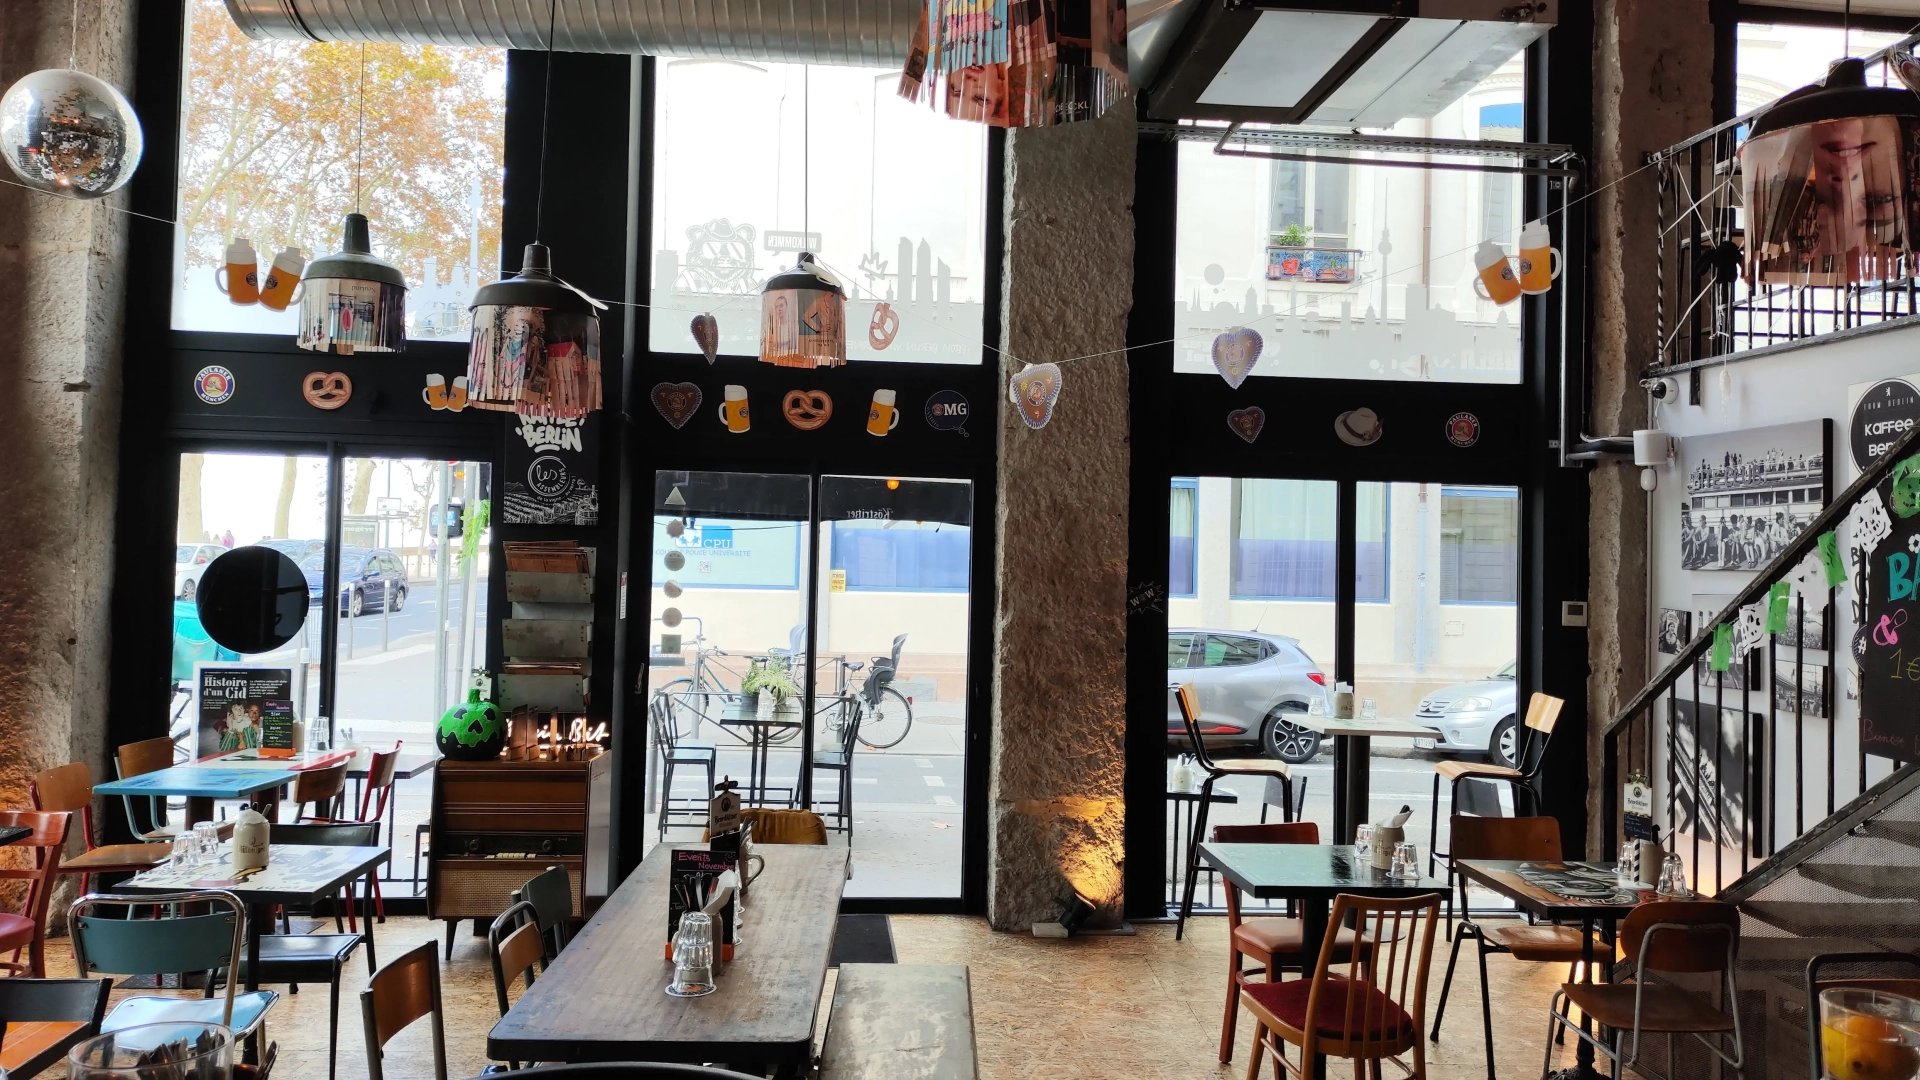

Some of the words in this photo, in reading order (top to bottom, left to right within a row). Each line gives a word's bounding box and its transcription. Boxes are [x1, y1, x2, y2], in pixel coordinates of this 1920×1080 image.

[197, 367, 231, 382] PAULANER
[703, 539, 731, 548] CPU
[203, 676, 248, 687] Histoire
[203, 688, 223, 697] d'un
[225, 686, 247, 699] Cid
[678, 851, 711, 862] Events
[698, 861, 735, 871] Novembre
